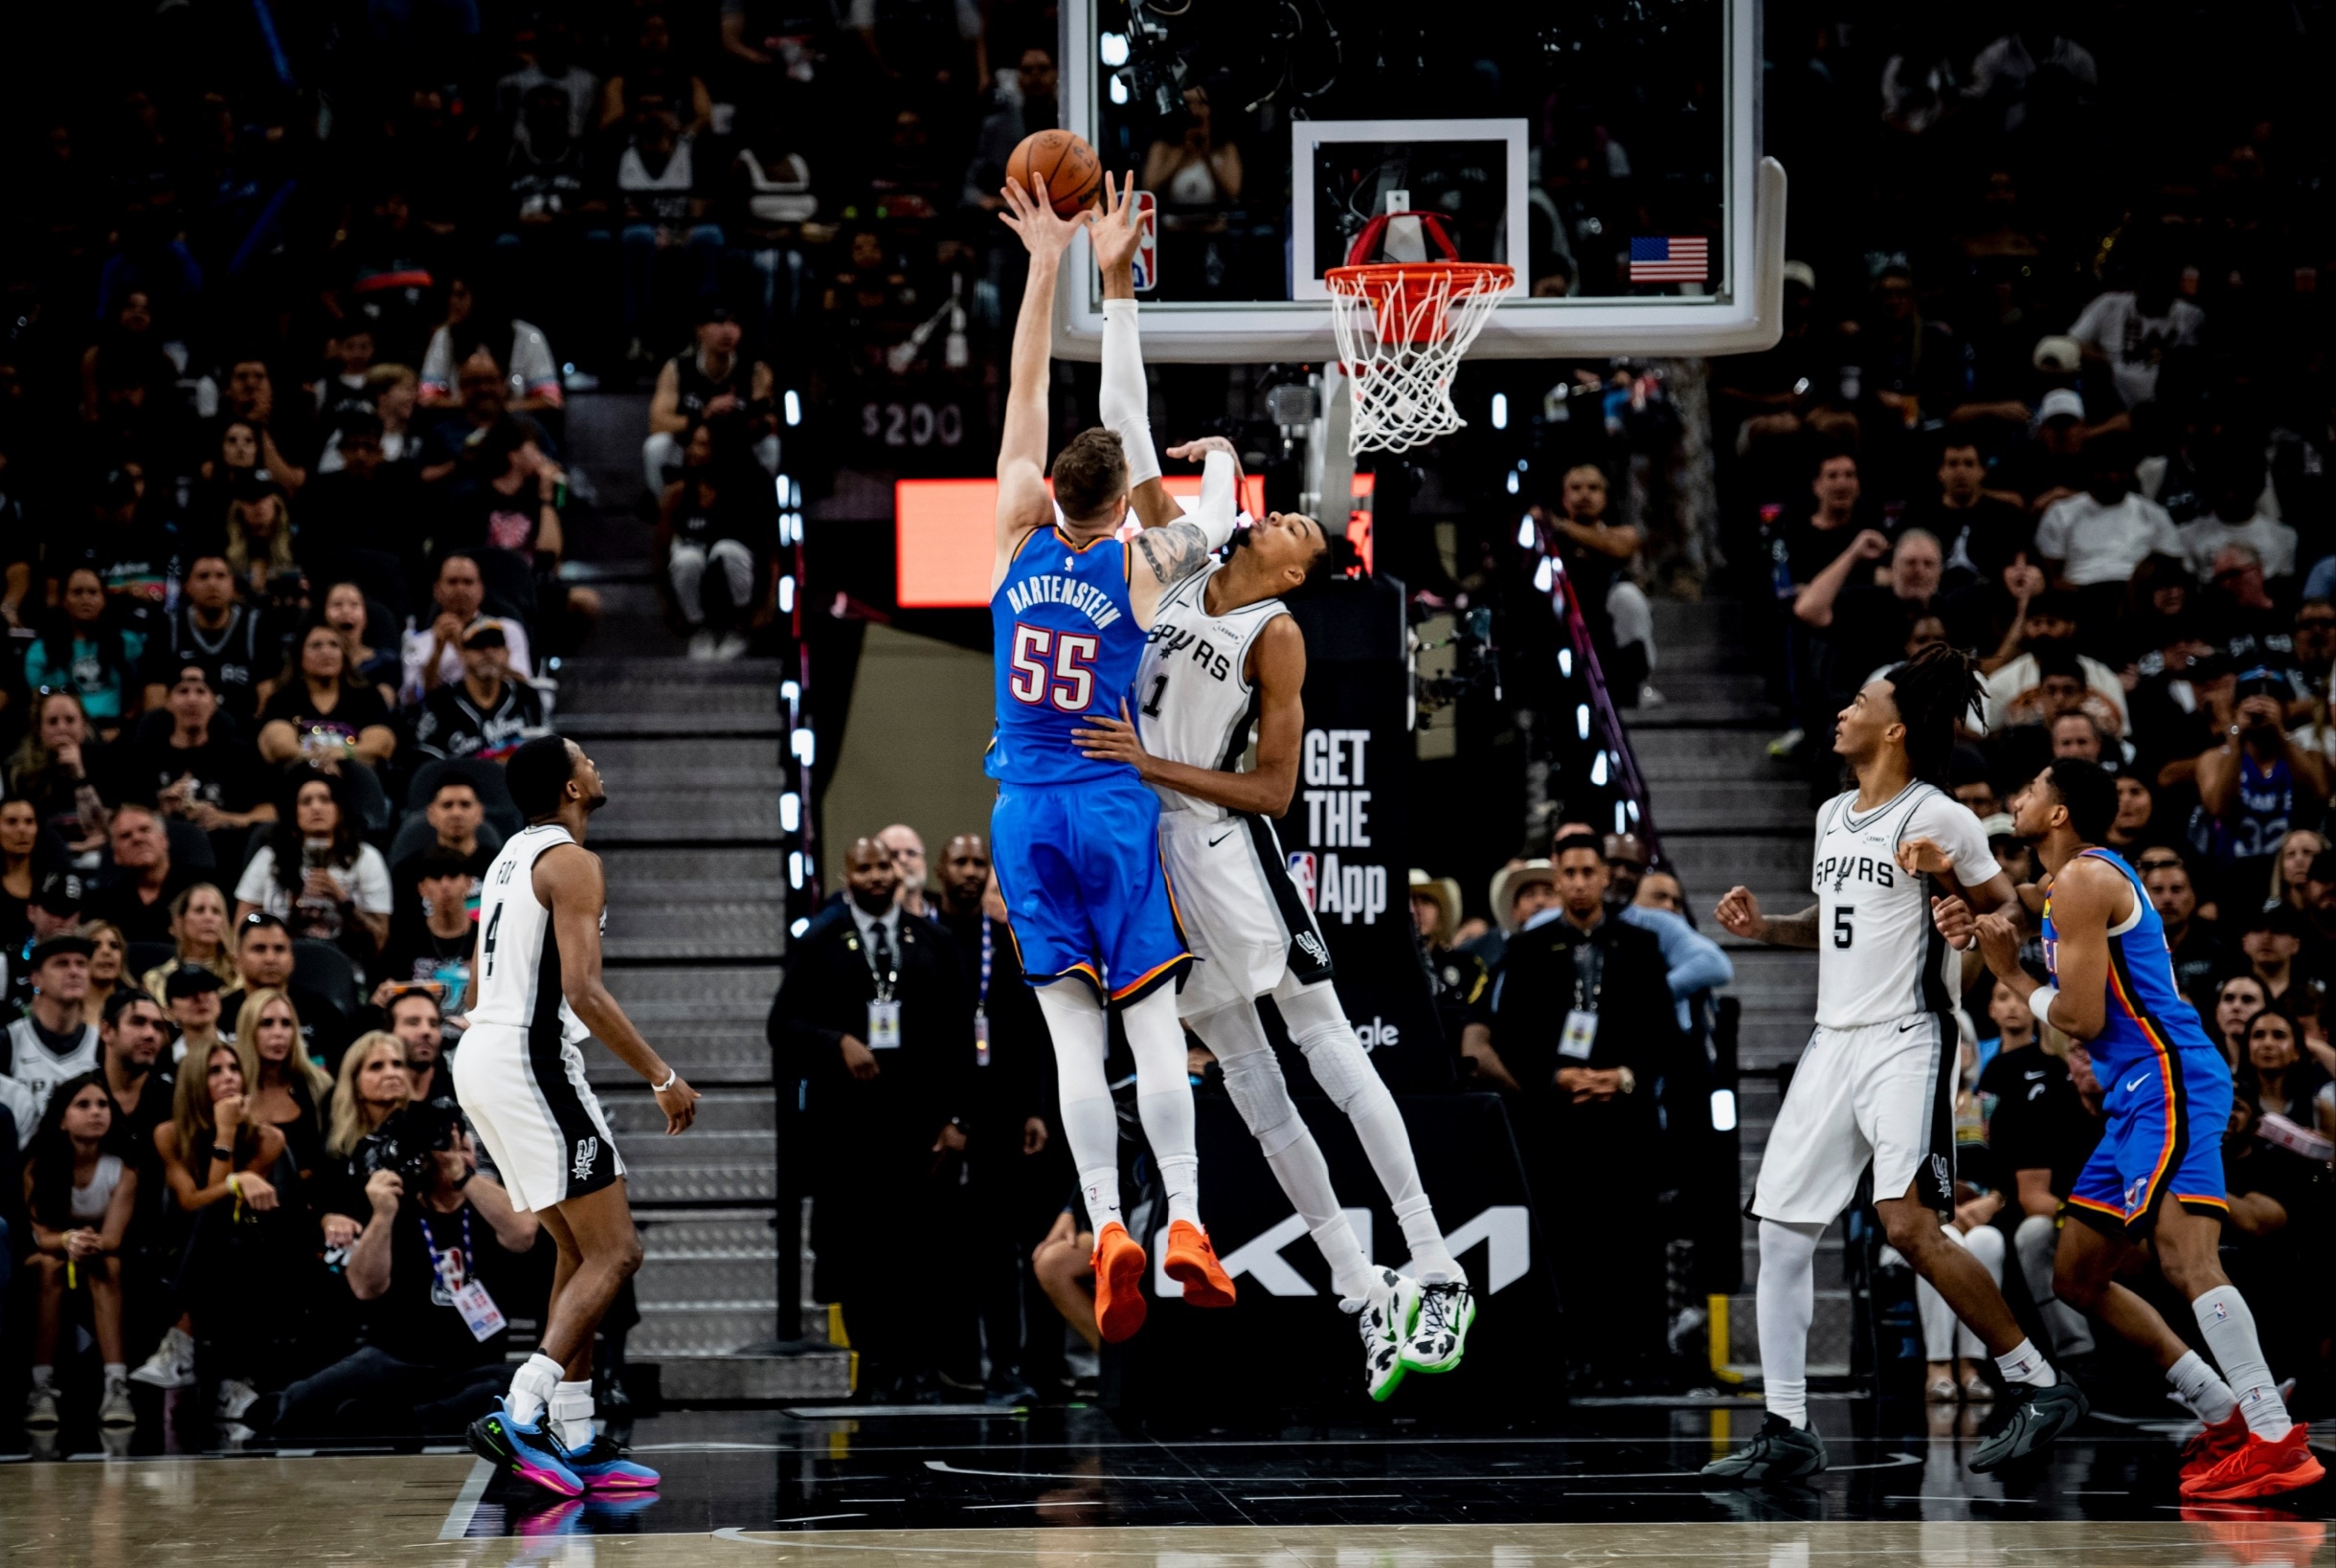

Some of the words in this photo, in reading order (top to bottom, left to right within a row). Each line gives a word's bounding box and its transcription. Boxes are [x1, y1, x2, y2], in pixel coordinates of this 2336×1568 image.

[861, 401, 963, 448] $200
[1006, 574, 1121, 630] HARTENSTEIN
[1010, 622, 1100, 713] 55
[1138, 672, 1170, 722] 1
[1304, 728, 1371, 786] GET
[1303, 790, 1372, 847] THE
[1318, 853, 1387, 925] App
[1817, 856, 1895, 892] SPURS
[483, 898, 505, 980] 4
[1833, 904, 1855, 952] 5
[1355, 1015, 1400, 1054] gle
